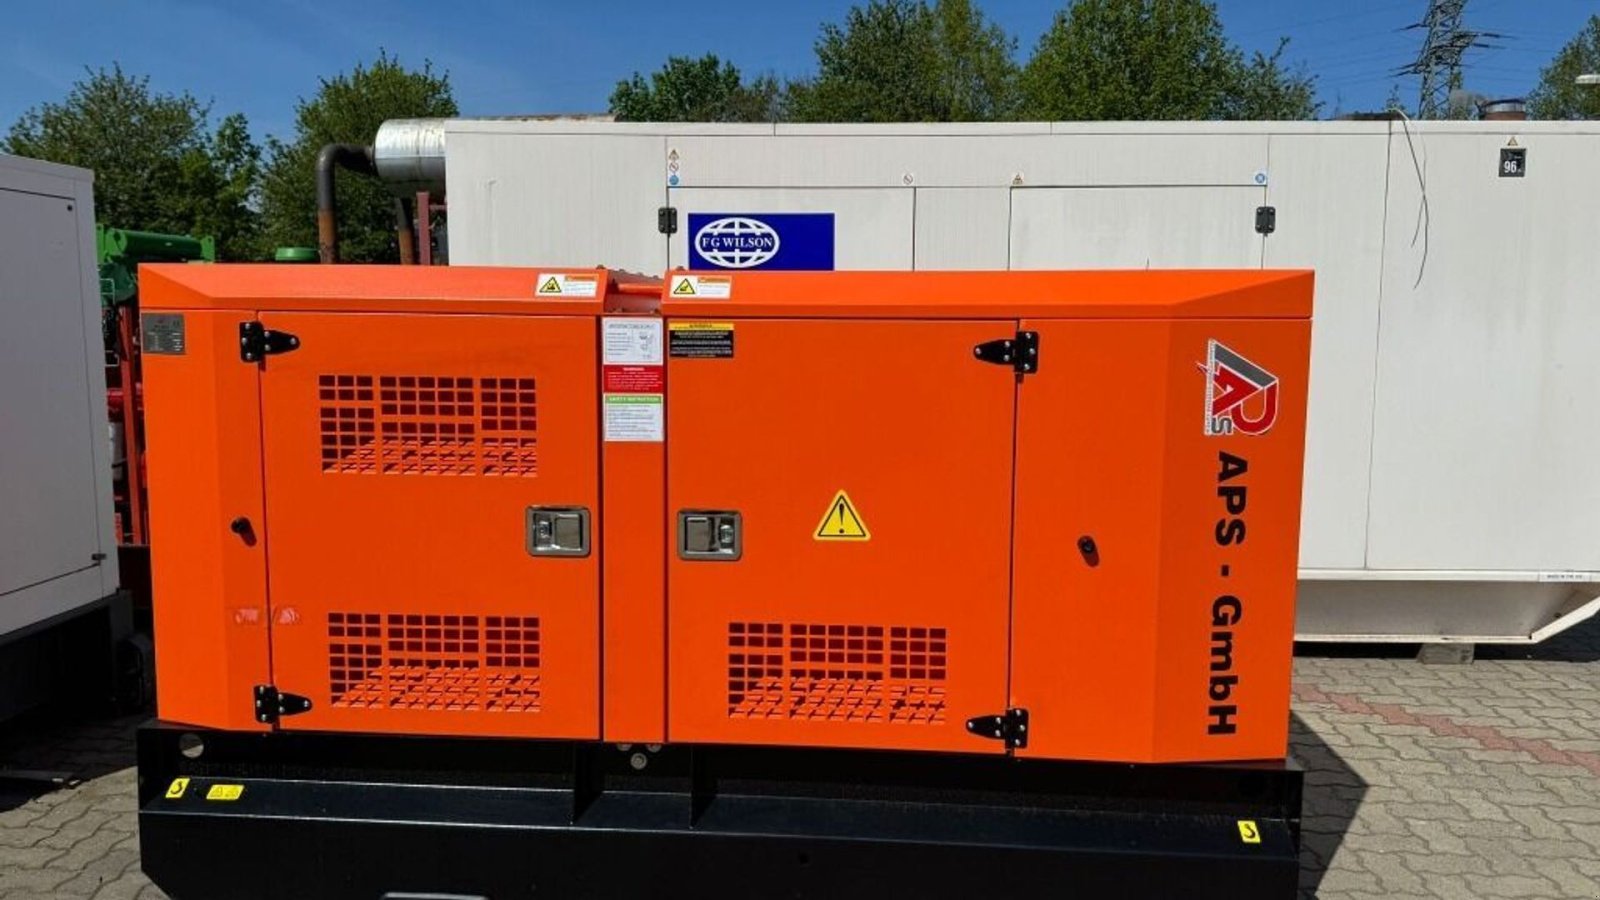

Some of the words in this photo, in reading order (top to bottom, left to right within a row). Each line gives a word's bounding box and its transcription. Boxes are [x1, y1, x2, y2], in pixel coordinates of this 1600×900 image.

[1504, 160, 1517, 173] 96
[722, 237, 773, 248] WILSON
[1214, 451, 1248, 546] APS
[1207, 595, 1243, 736] GmbH
